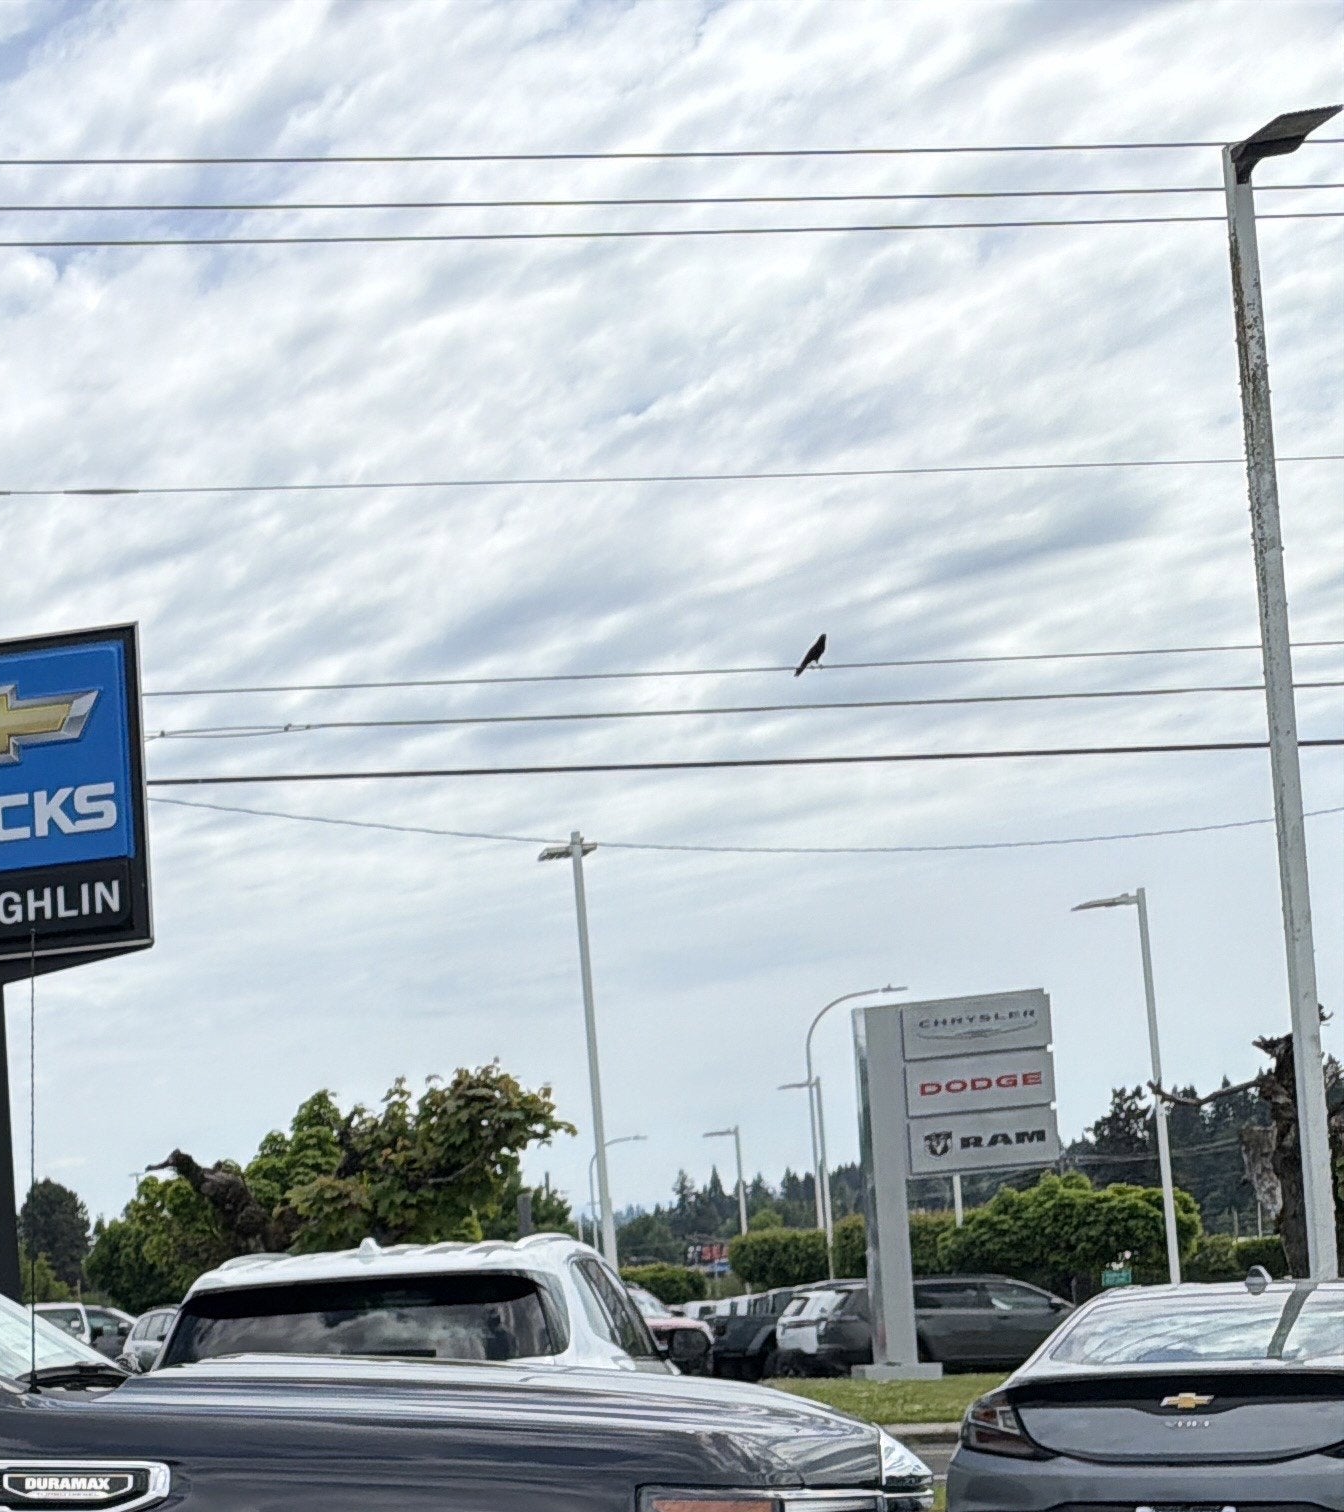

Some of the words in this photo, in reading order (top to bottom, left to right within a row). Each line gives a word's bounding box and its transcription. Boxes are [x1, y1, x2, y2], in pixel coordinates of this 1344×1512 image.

[918, 1008, 1035, 1029] CHRYSLER
[920, 1071, 1043, 1097] DODGE
[960, 1129, 1047, 1150] RAM
[24, 1476, 111, 1491] DURAMAX
